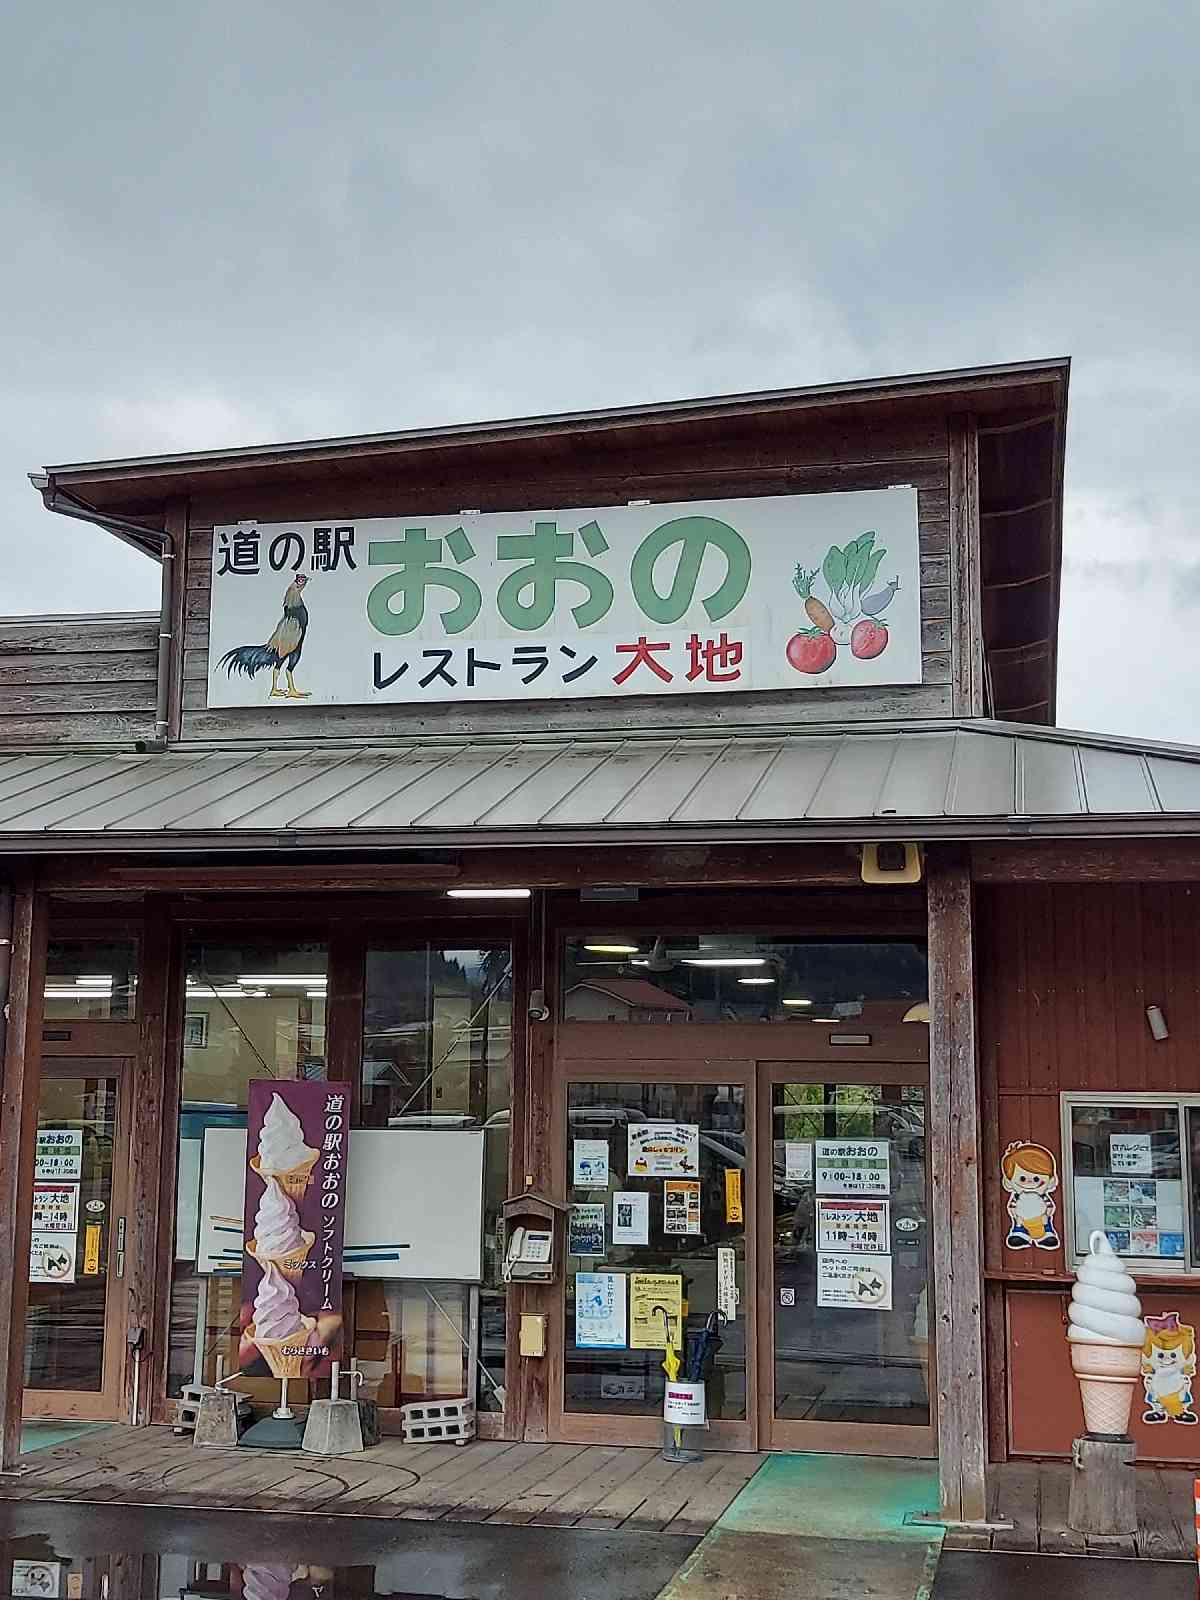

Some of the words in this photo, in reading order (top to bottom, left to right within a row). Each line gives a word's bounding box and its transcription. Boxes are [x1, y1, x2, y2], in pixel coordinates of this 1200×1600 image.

[217, 526, 358, 577] 道の駅
[366, 516, 752, 636] おおの
[374, 632, 744, 689] レストラン大地
[321, 1095, 345, 1209] 道の駅おおの
[822, 1146, 878, 1156] 道の駅おおの
[284, 1259, 317, 1269] ミックス
[320, 1215, 336, 1310] ソフトクリーム
[281, 1345, 329, 1356] むらさきいも
